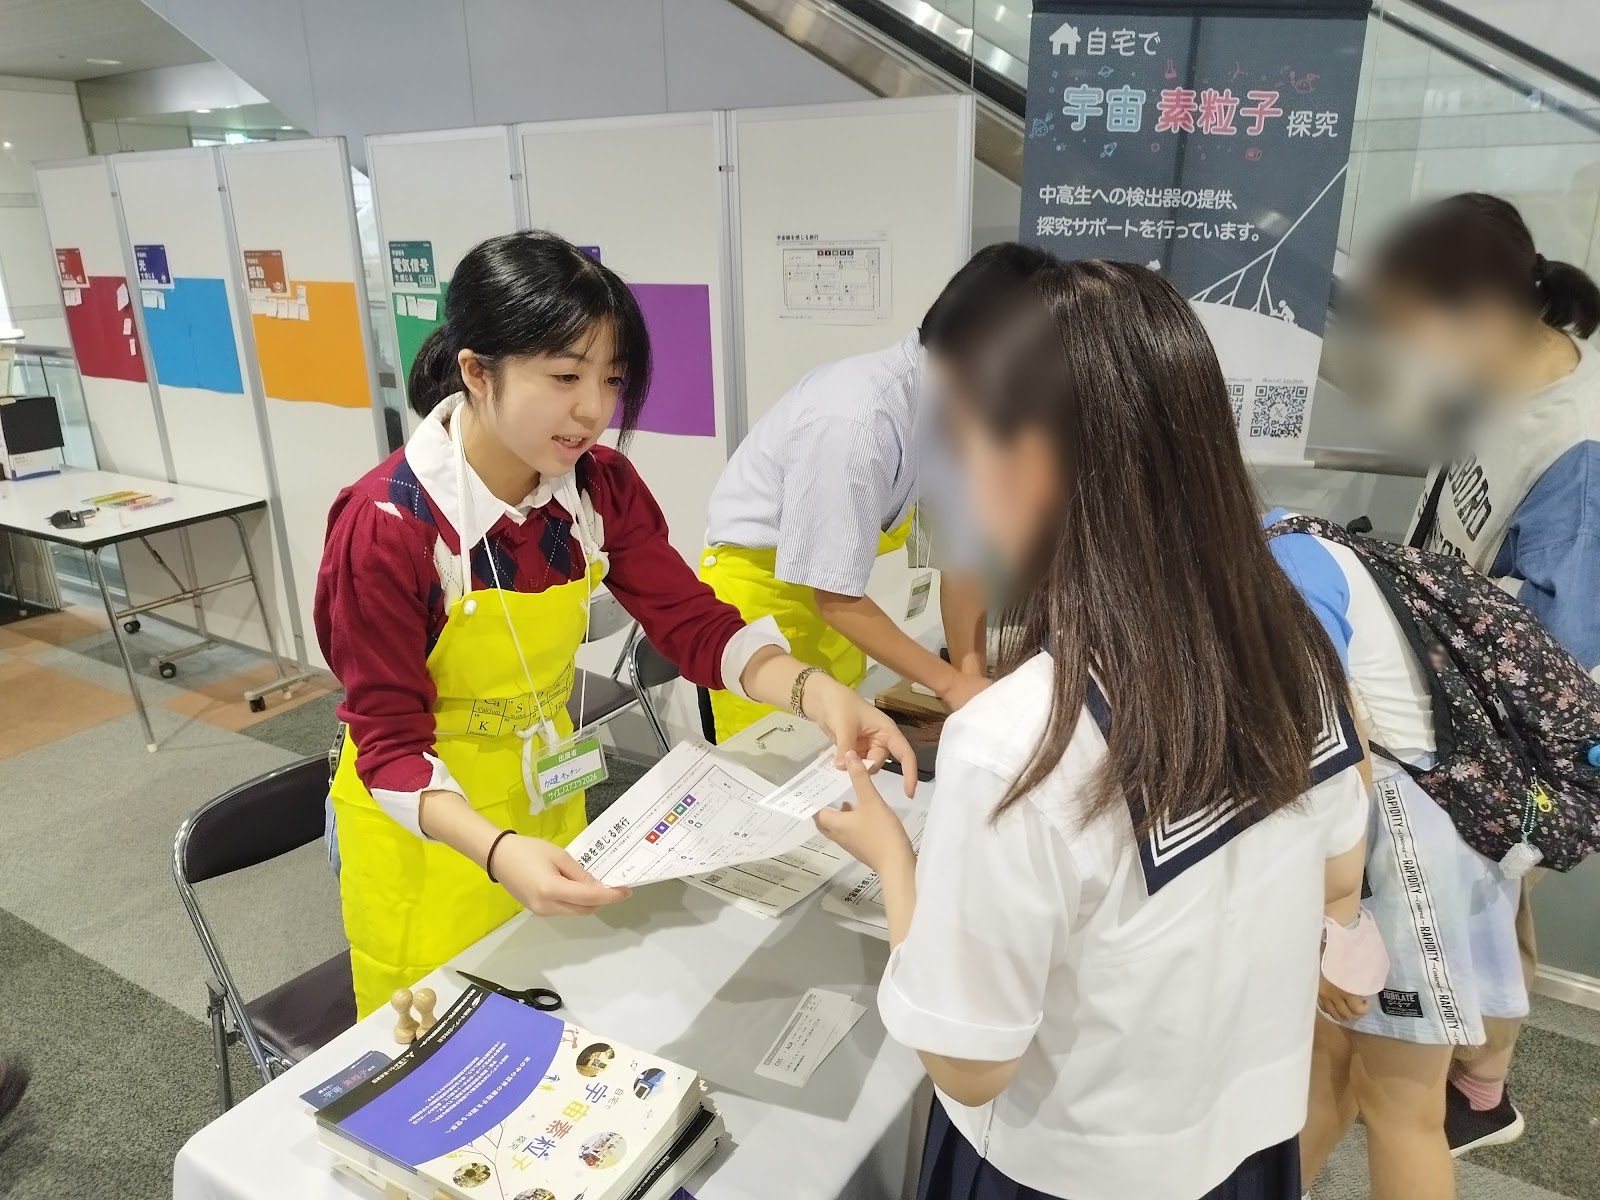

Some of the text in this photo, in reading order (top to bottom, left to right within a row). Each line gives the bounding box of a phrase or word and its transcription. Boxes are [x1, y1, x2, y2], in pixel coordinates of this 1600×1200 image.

[1087, 26, 1161, 57] 自宅で
[1062, 83, 1339, 138] 宇宙 素粒子 探究
[1039, 184, 1238, 210] 中高生への検出器の提供、
[1036, 216, 1260, 242] 探究サポートを行っています。
[479, 721, 490, 731] K
[1384, 789, 1404, 828] RAPIDITY
[1402, 860, 1422, 894] RAPIDITY
[1420, 926, 1440, 962] RAPIDITY
[1382, 991, 1416, 1003] JUBILATE
[1438, 994, 1460, 1030] RAPIDITY
